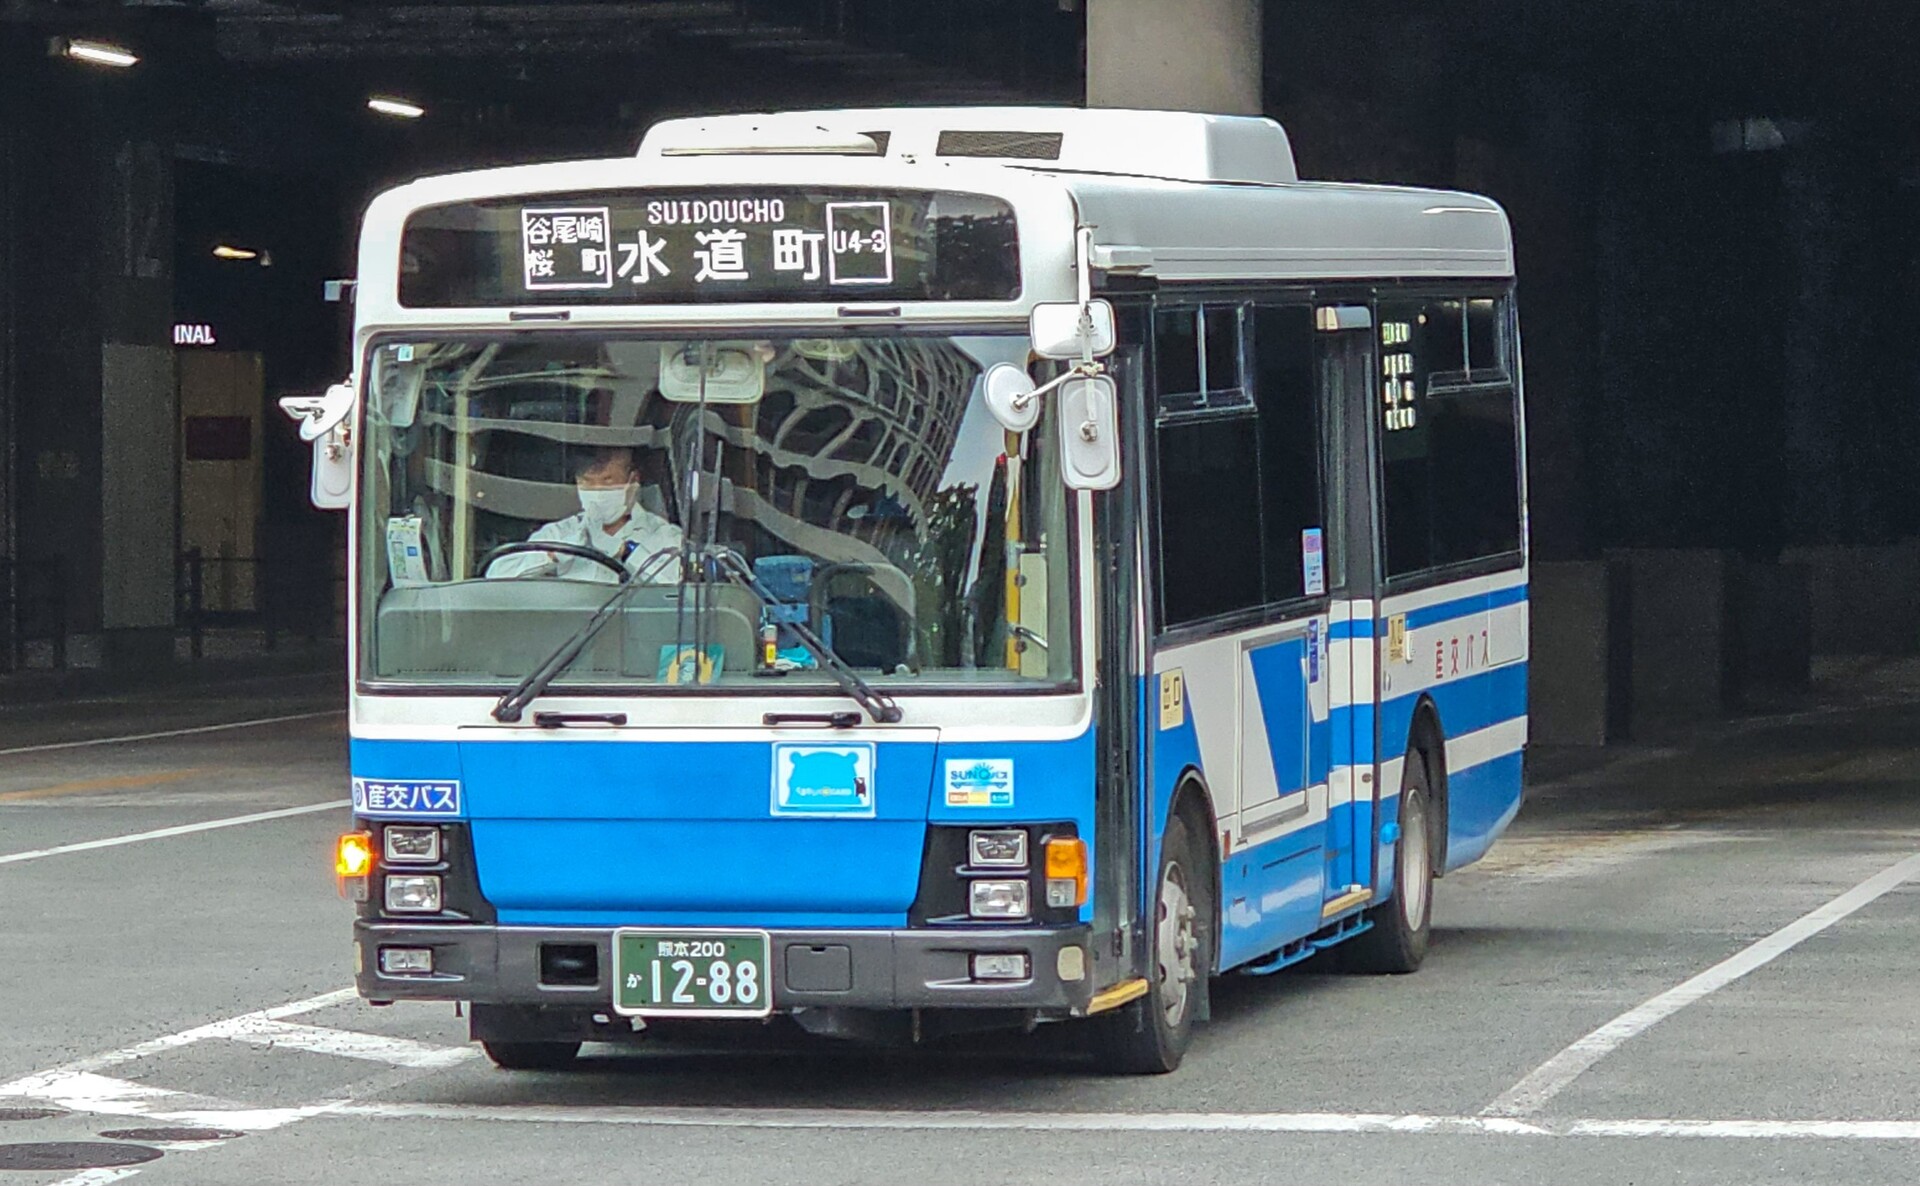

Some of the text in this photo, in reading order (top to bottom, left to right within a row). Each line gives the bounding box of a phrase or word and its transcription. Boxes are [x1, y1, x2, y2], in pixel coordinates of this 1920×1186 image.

[647, 199, 784, 225] SUIDOUCHO
[526, 216, 604, 244] 谷尾崎
[832, 229, 886, 254] U4-3
[616, 229, 826, 284] 水道町
[174, 324, 216, 344] INAL
[368, 784, 455, 809] 産交バス
[651, 960, 758, 1004] 12-88
